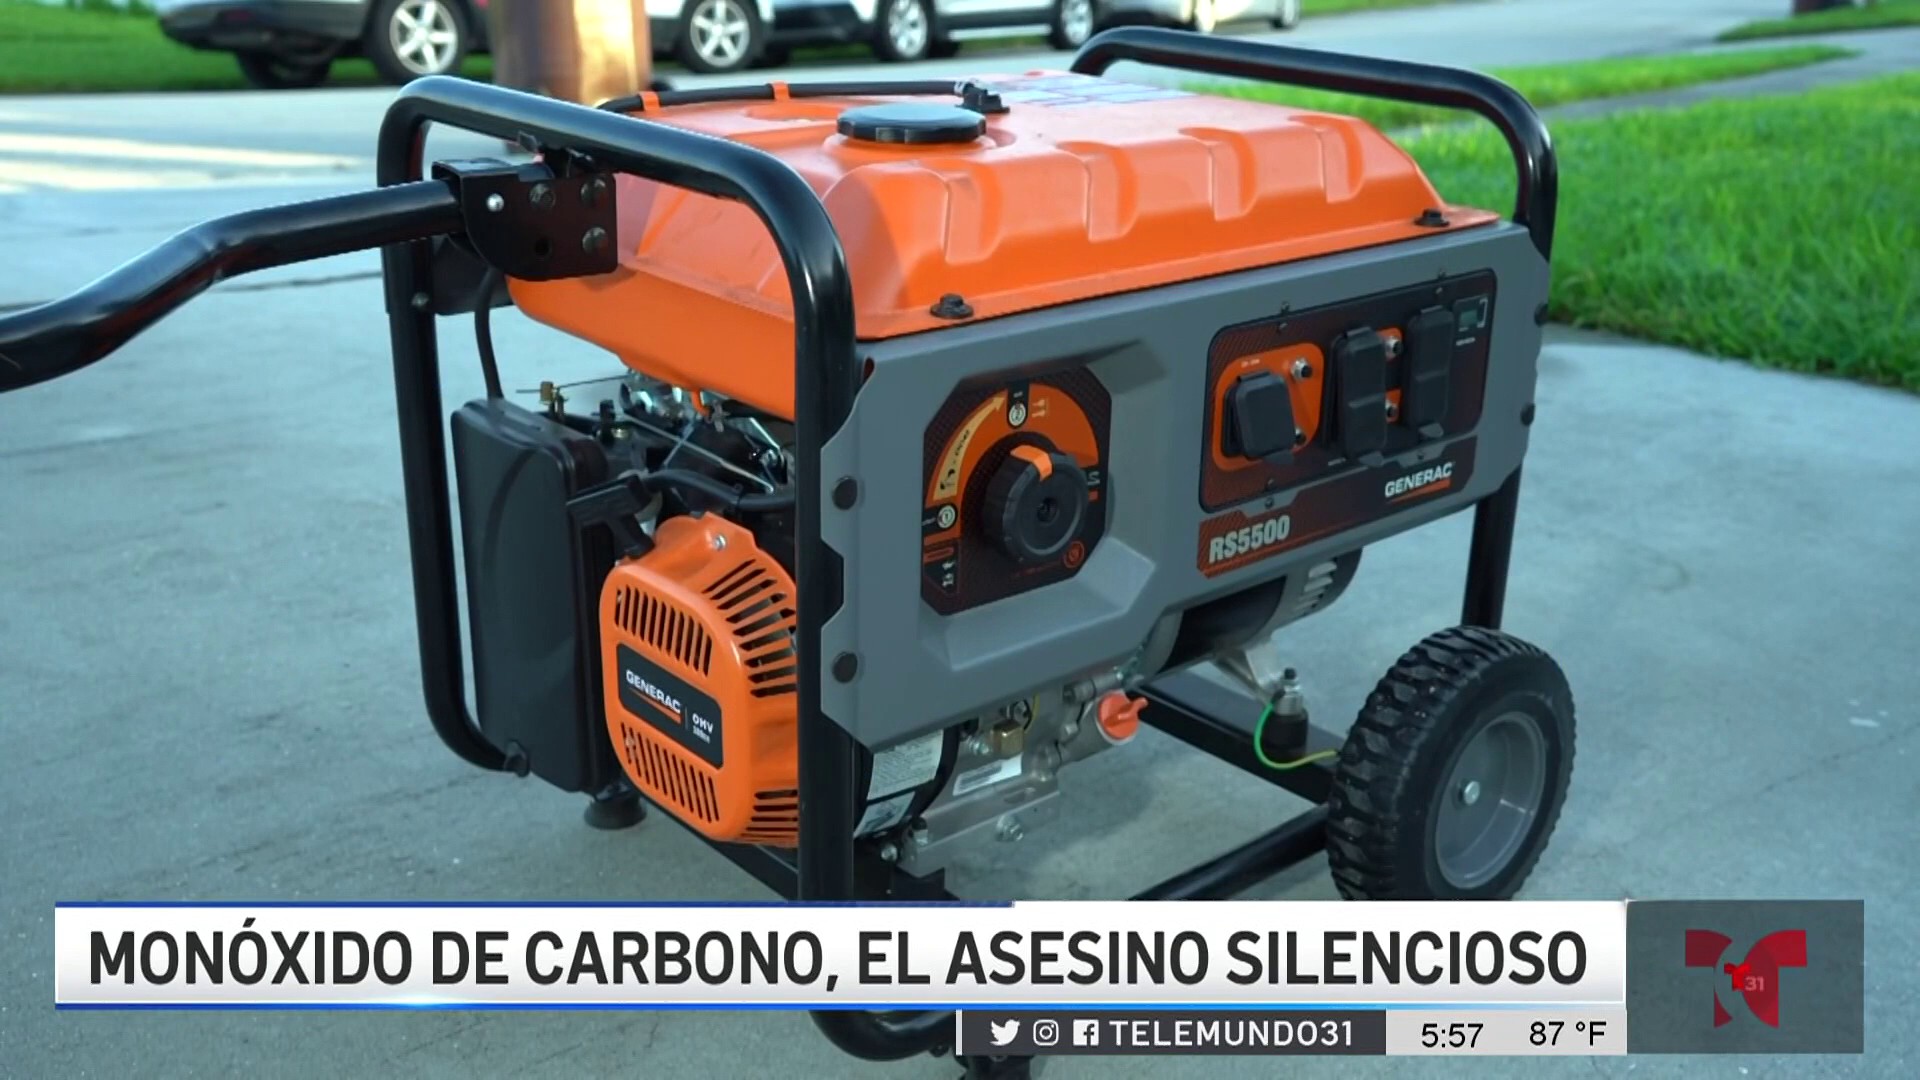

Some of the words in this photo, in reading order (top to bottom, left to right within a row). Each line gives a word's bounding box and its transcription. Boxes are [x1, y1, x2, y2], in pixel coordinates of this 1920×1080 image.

[1384, 461, 1454, 498] GENERAC
[1208, 515, 1291, 564] RS5500
[625, 669, 682, 714] GENERAC
